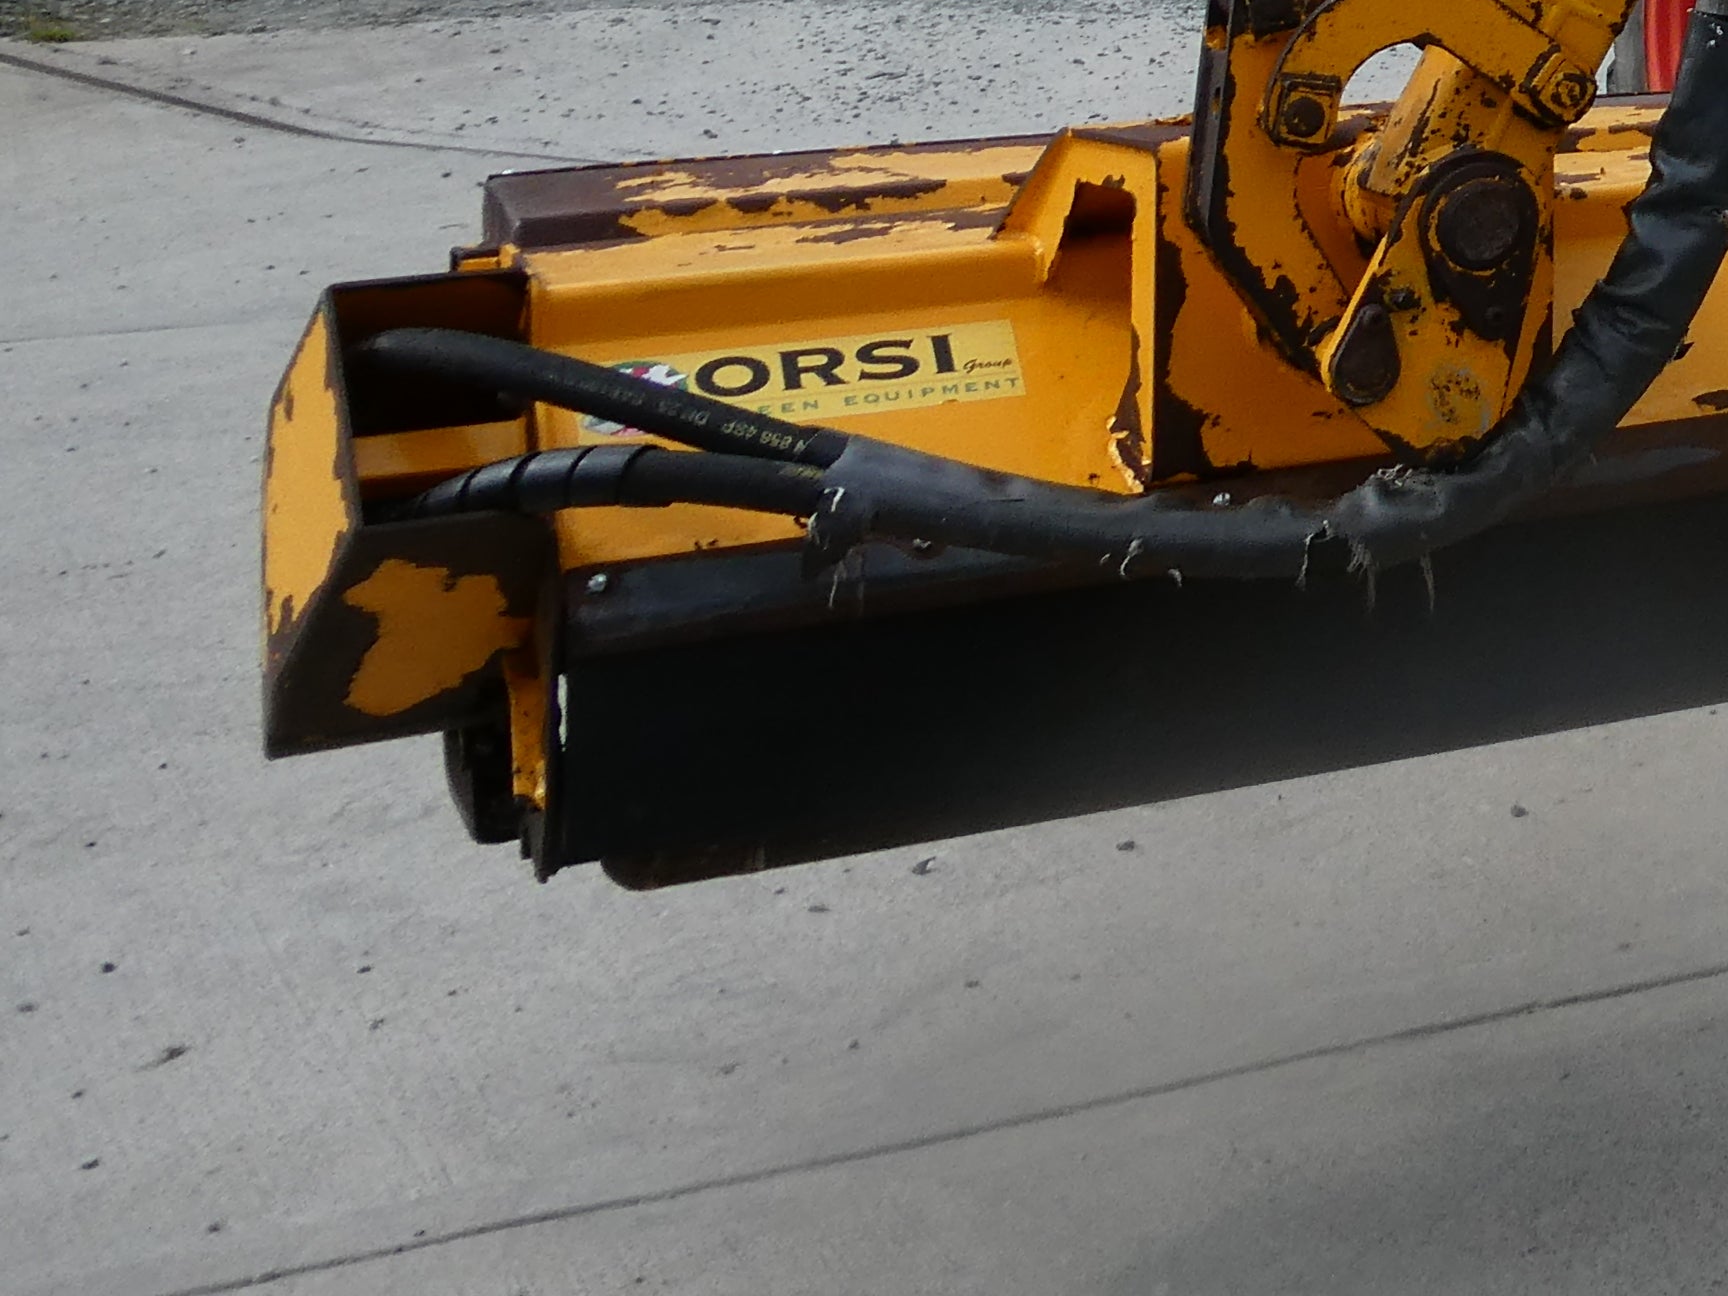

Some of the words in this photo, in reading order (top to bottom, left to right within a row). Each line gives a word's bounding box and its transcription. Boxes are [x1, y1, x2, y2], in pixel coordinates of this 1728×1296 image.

[694, 334, 957, 397] ORSI
[963, 358, 1013, 374] Group
[844, 377, 1019, 407] EQUIPMENT
